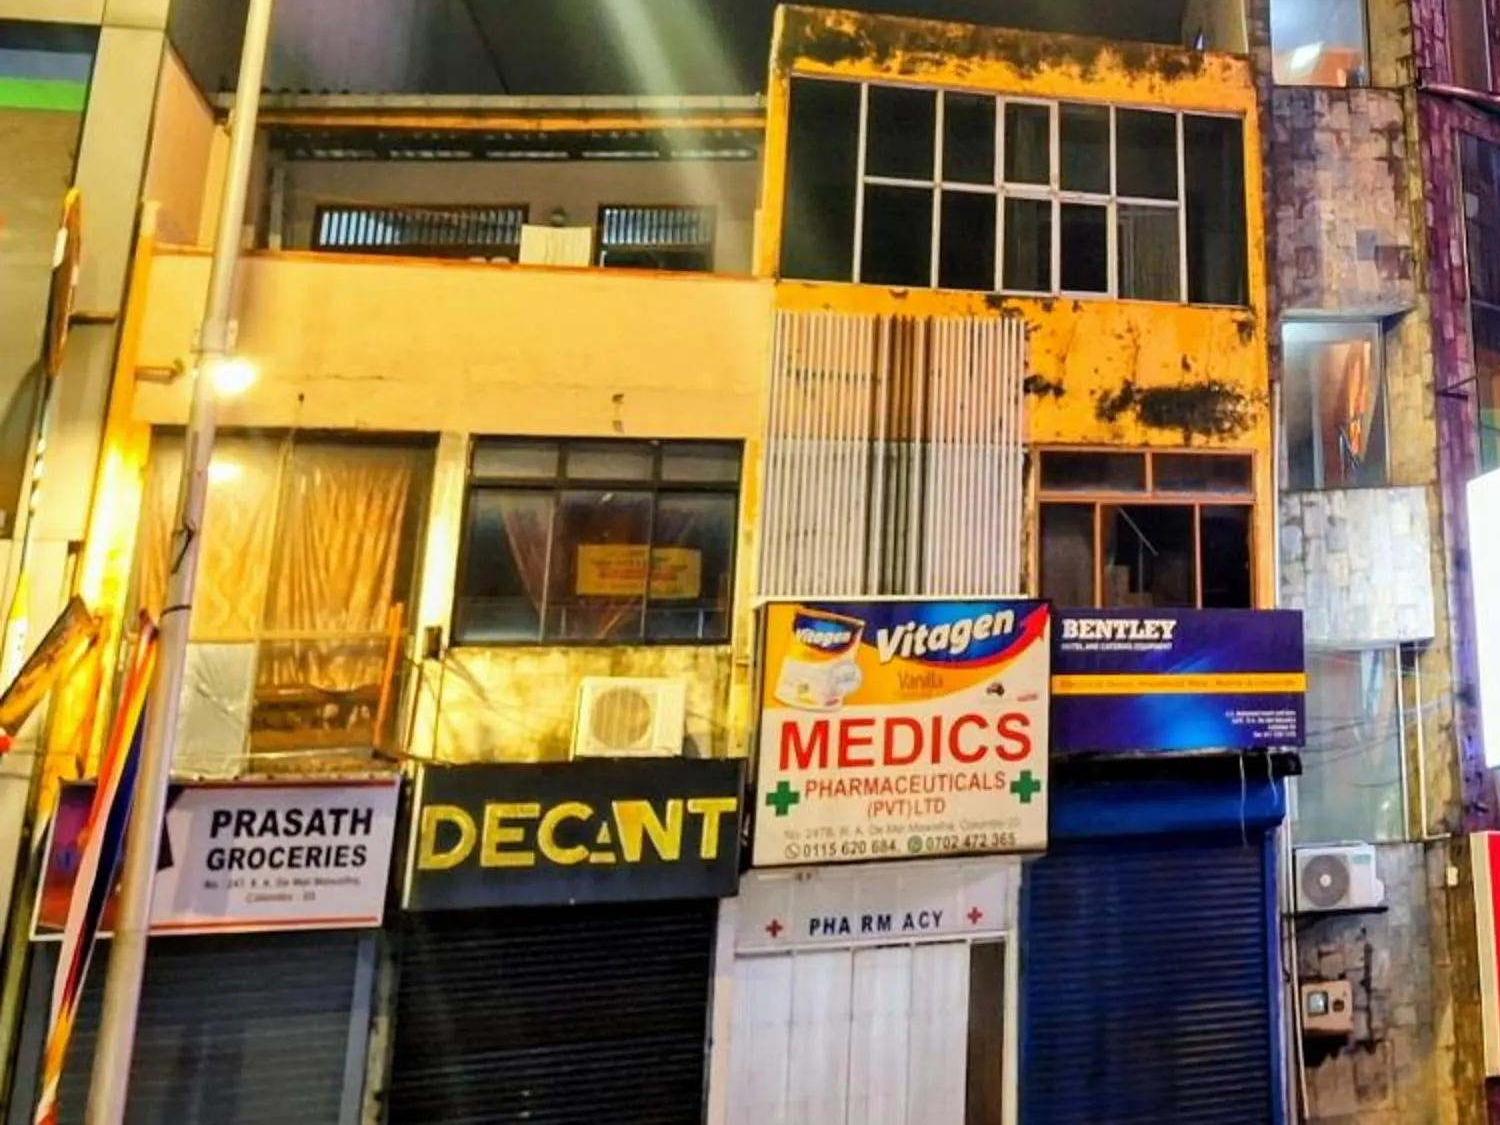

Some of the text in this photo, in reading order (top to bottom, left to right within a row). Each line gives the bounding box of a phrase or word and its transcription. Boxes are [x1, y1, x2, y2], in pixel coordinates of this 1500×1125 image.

[876, 609, 1015, 664] Vitagen
[1061, 618, 1177, 640] BENTLEY
[897, 670, 943, 689] Vanilla
[779, 712, 1032, 771] MEDICS
[804, 771, 1006, 799] PHARMACEUTICALS
[914, 797, 946, 815] LTD
[210, 808, 373, 838] PRASATH
[418, 797, 738, 870] DECANT
[206, 845, 367, 871] GROCERIES
[803, 842, 837, 858] 0115
[841, 839, 867, 855] 620
[925, 835, 959, 852] 0702
[963, 832, 987, 849] 472
